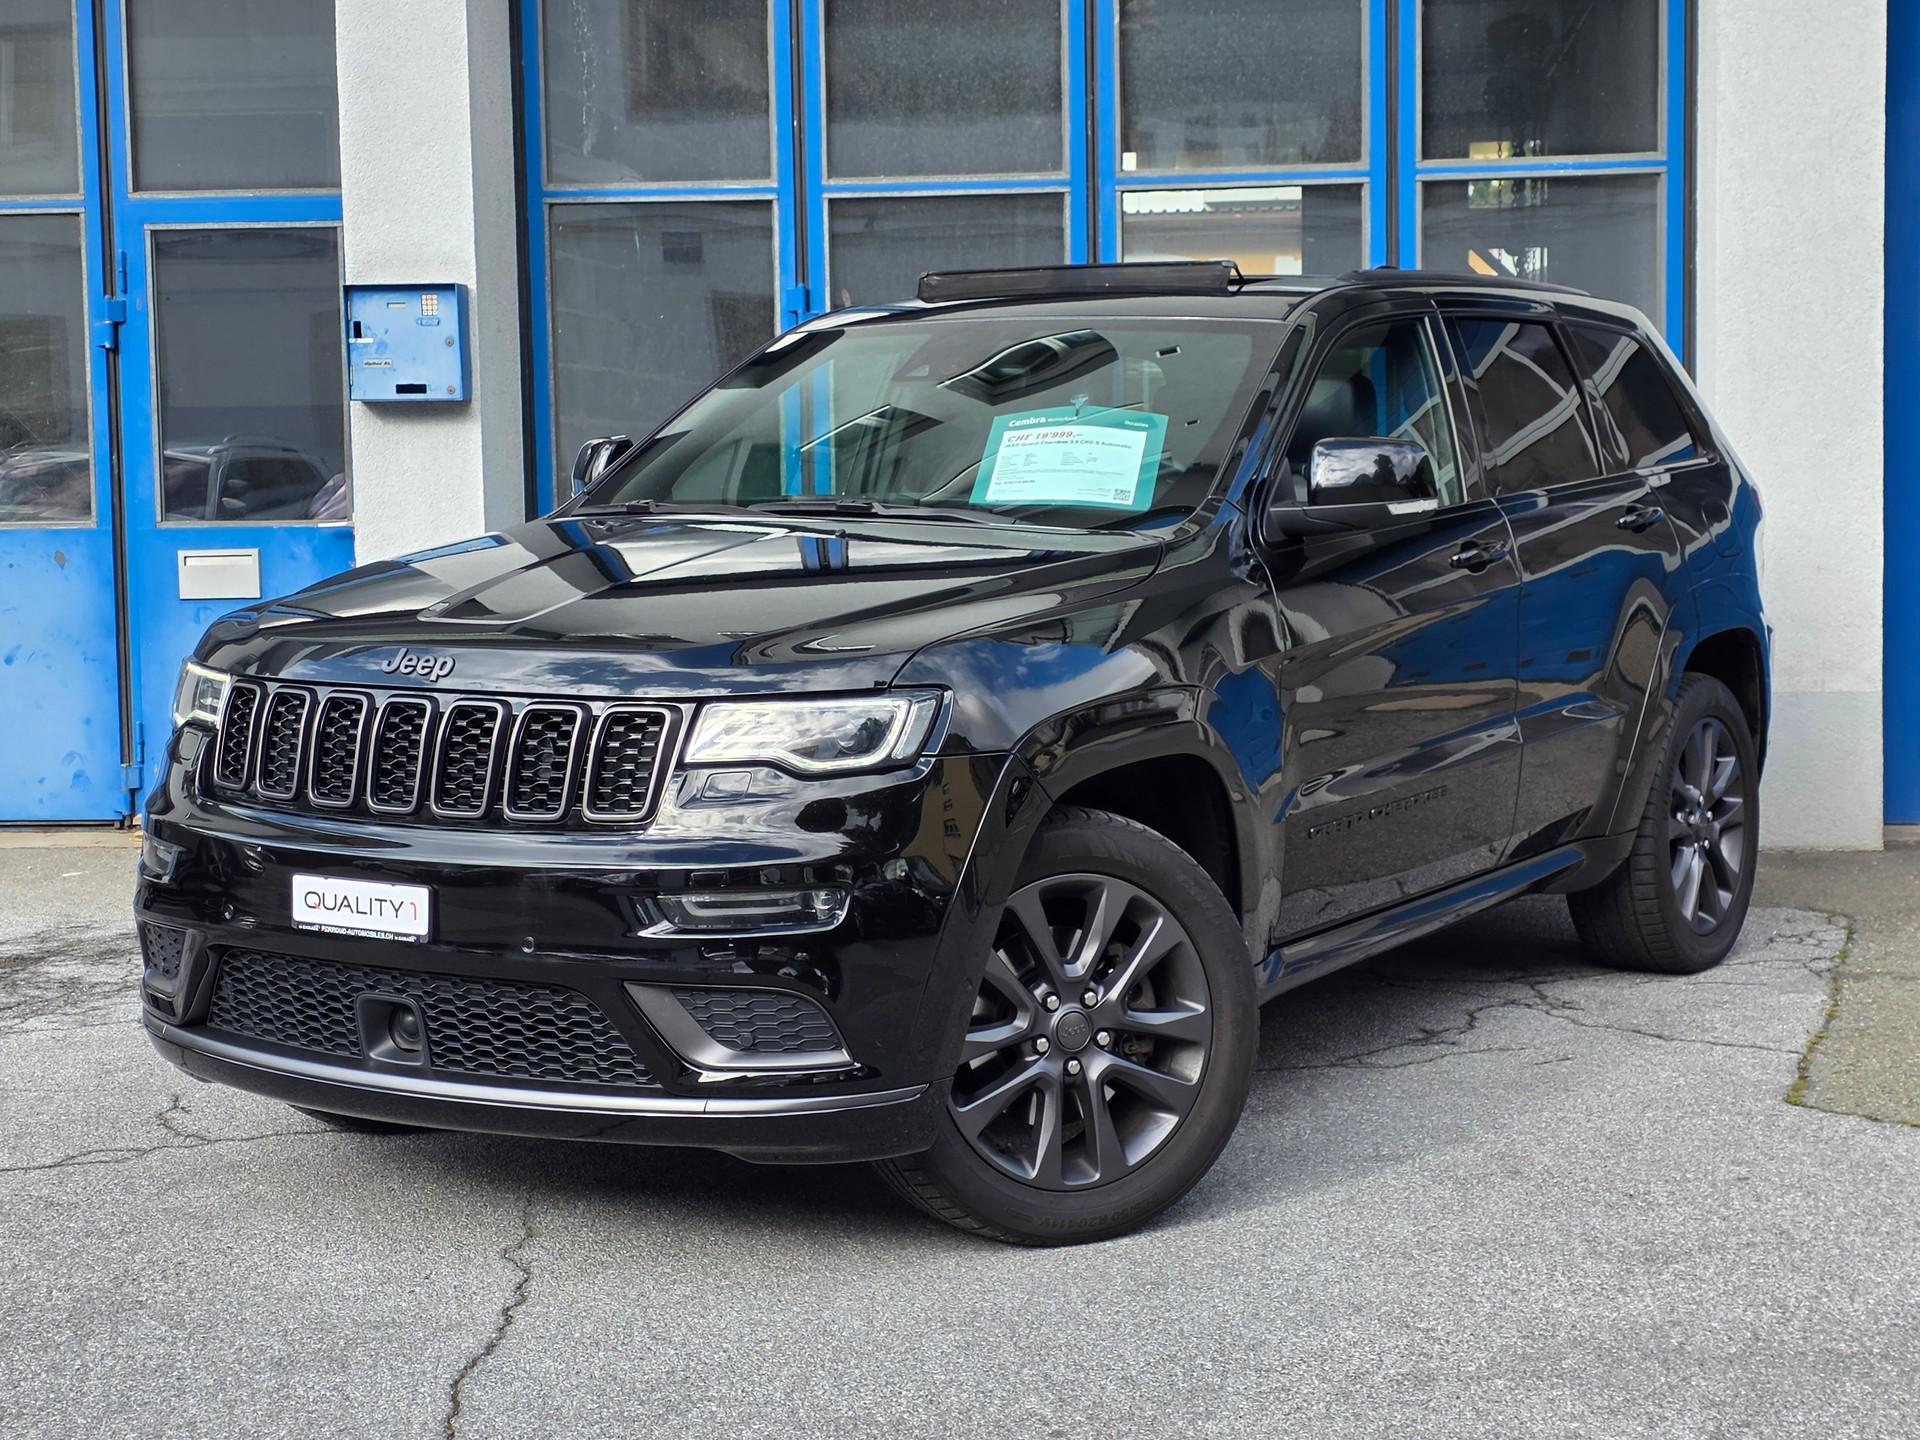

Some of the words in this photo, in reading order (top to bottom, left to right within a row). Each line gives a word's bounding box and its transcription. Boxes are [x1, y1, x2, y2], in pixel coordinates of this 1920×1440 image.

[1008, 416, 1046, 428] Cembra
[1007, 433, 1033, 443] CHF
[381, 647, 456, 682] Jeep
